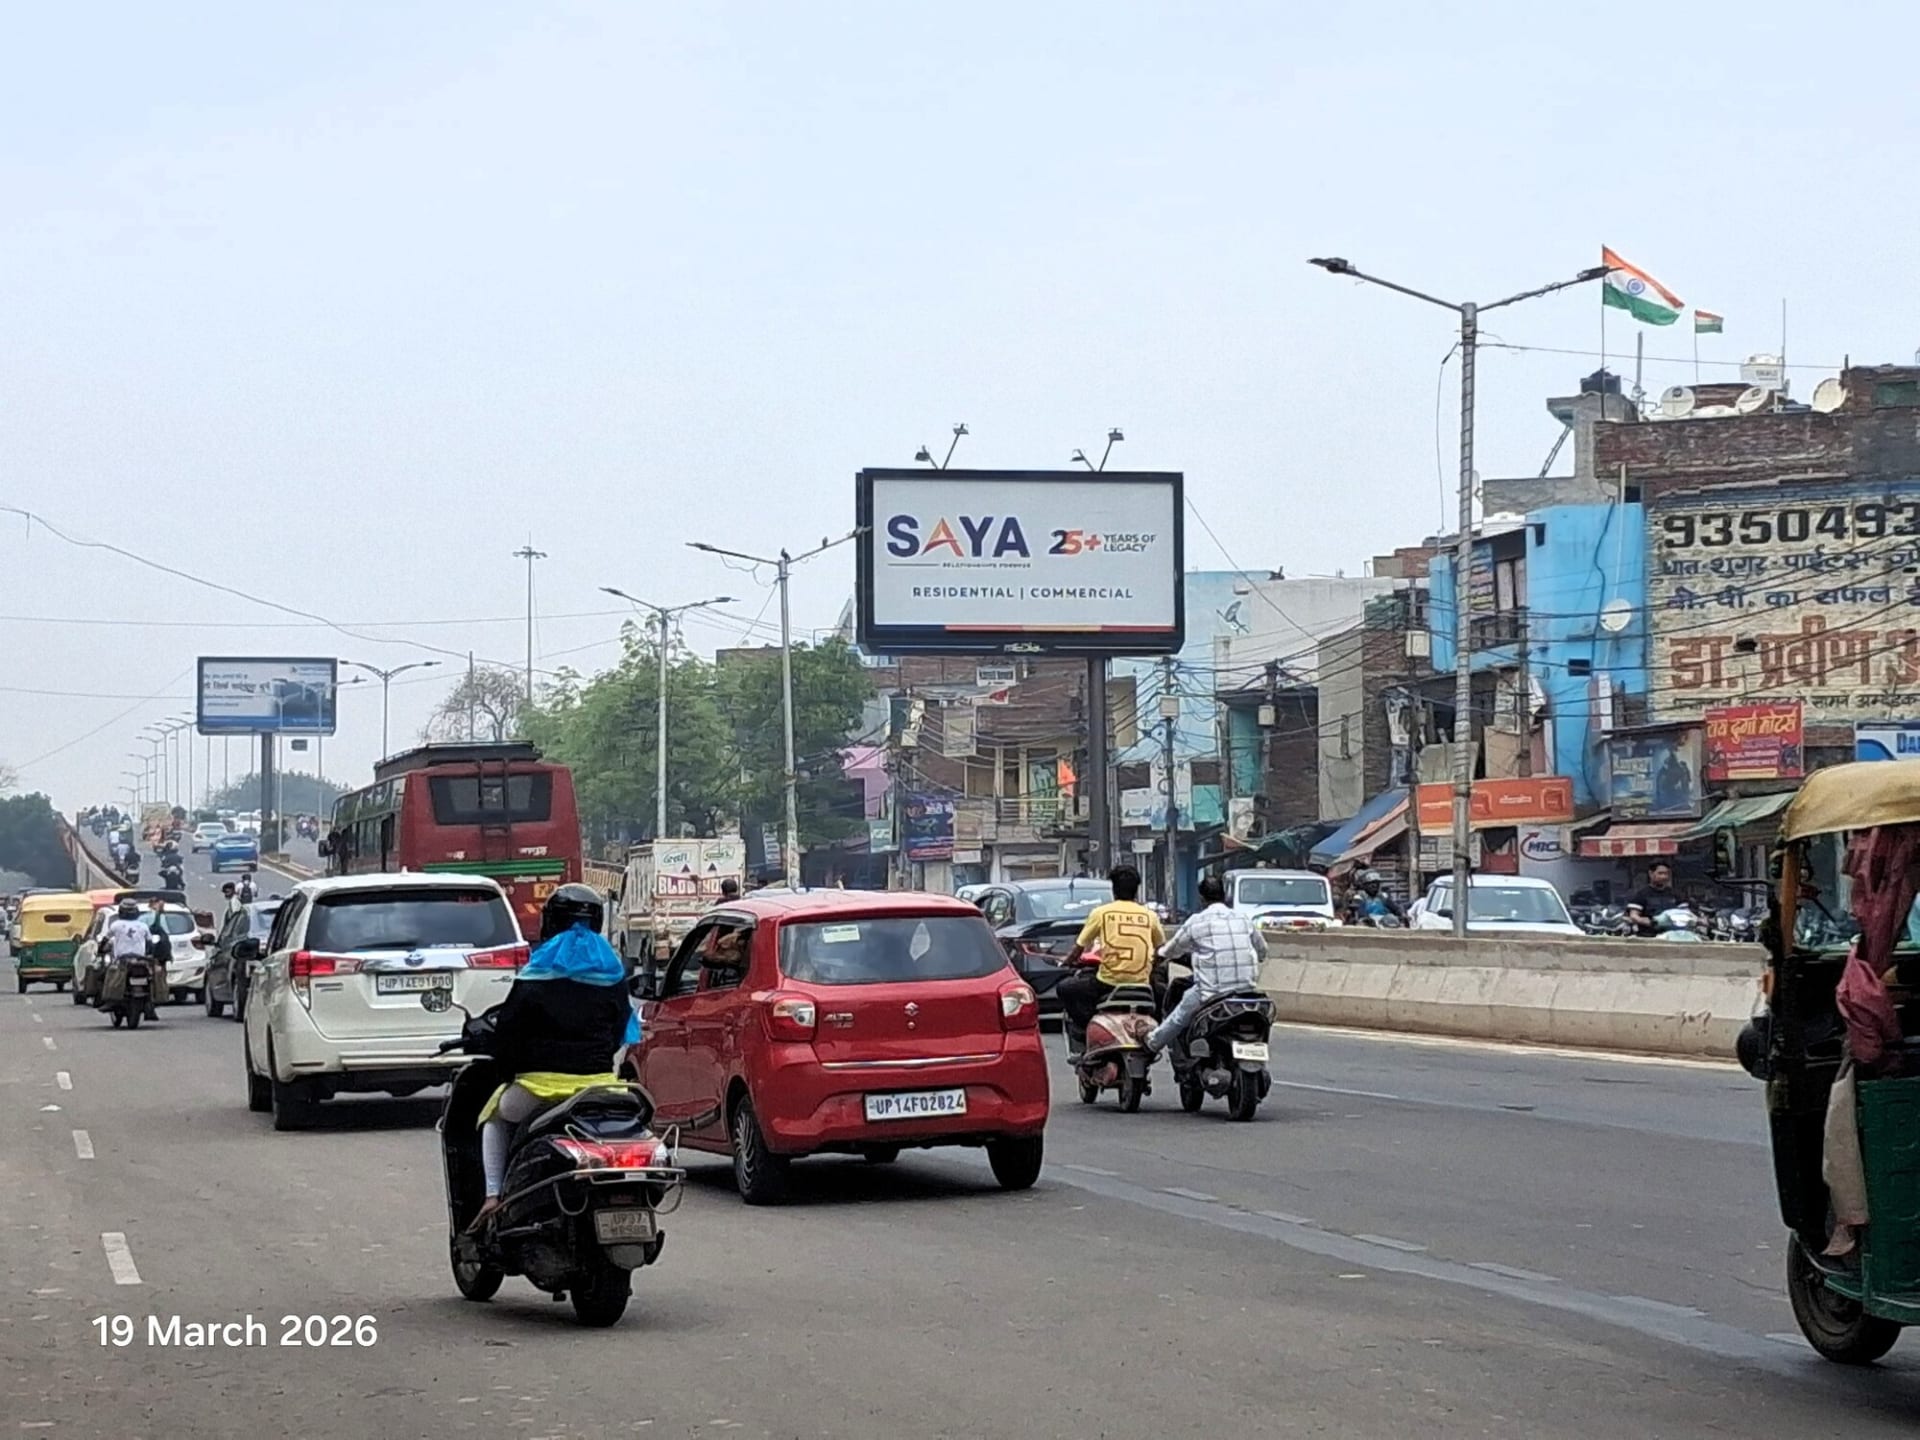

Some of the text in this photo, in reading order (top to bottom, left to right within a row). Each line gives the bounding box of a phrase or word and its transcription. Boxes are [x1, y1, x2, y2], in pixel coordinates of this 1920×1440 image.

[887, 515, 1030, 557] SAYA
[1049, 530, 1101, 555] 25+
[1103, 534, 1157, 543] YEARS OF
[1103, 544, 1147, 552] LEGACY
[912, 586, 1015, 598] RESIDENTIAL
[1030, 587, 1134, 599] COMMERCIAL
[1103, 910, 1149, 974] 5
